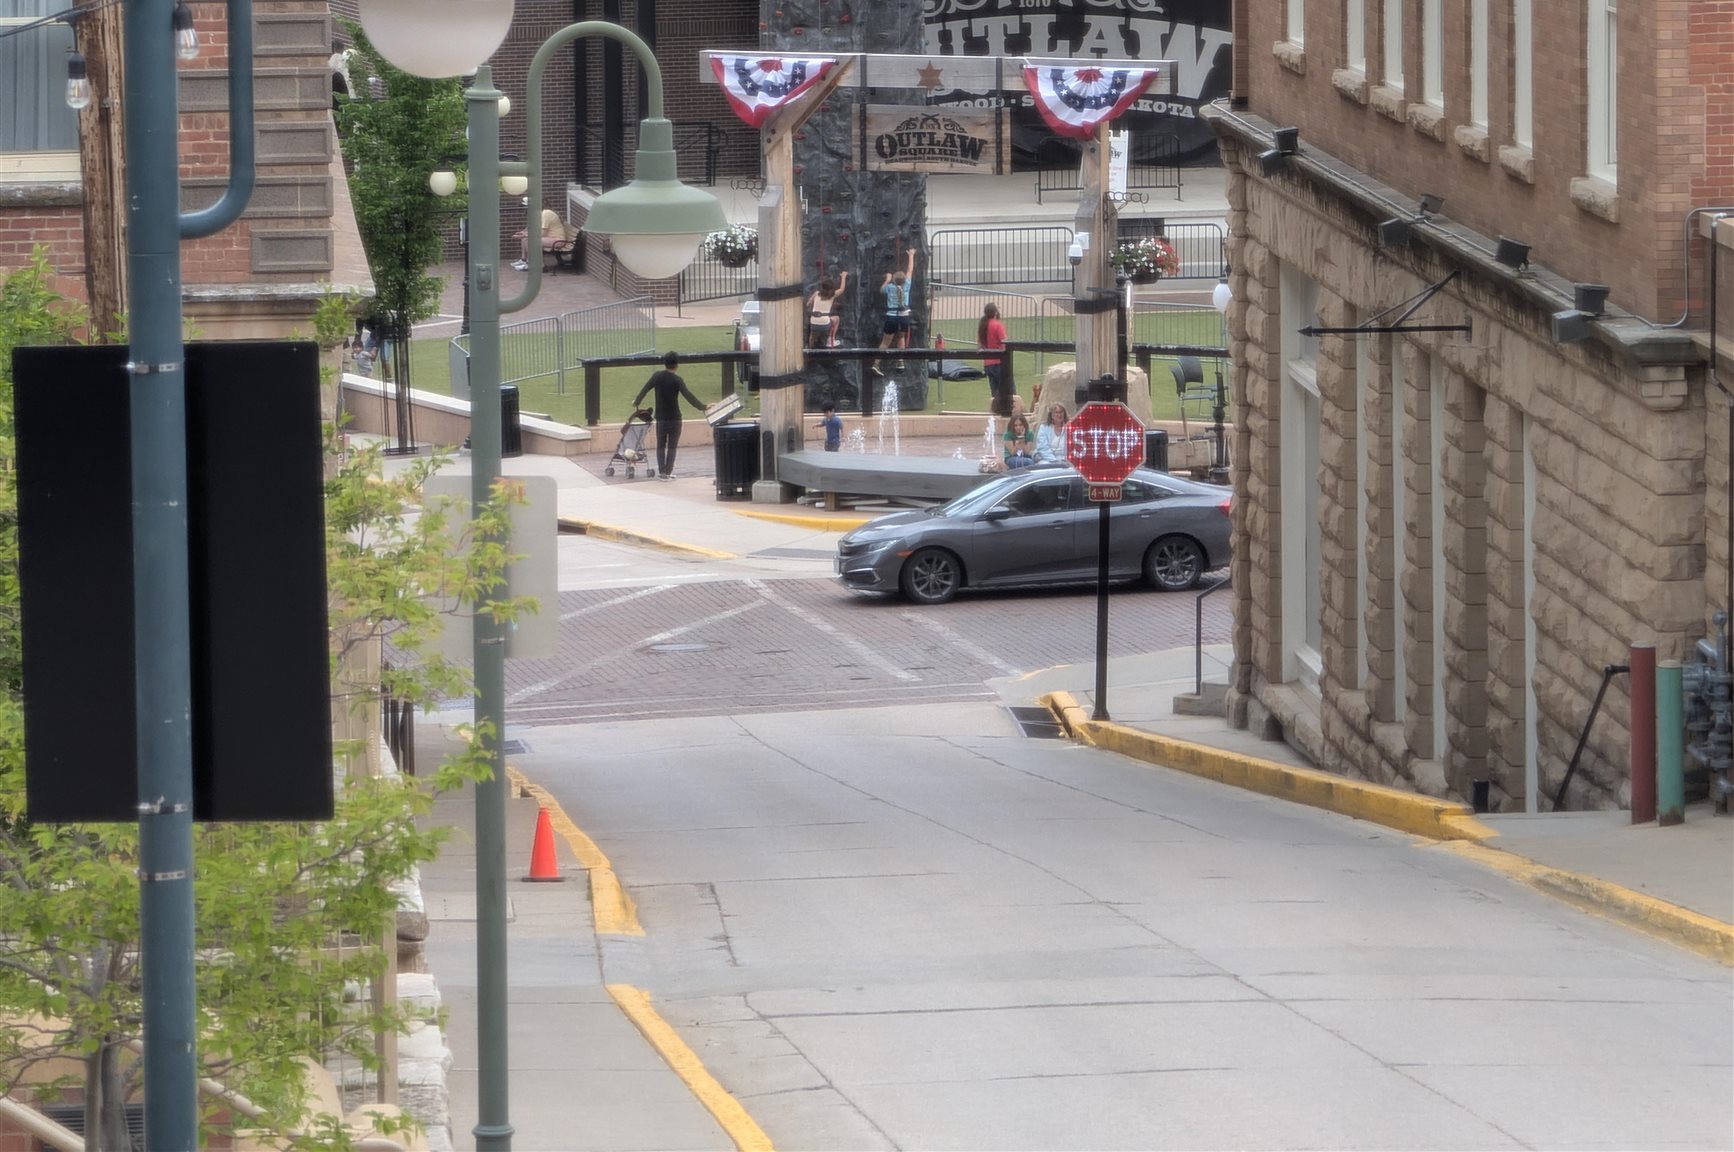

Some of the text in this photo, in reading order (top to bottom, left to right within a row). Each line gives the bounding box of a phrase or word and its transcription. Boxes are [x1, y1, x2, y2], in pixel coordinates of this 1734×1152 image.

[924, 13, 1232, 99] UTLAW
[1128, 98, 1196, 119] KOTA
[875, 131, 988, 161] OUTLAW
[899, 147, 958, 157] SQUARE
[1073, 428, 1138, 459] STOP
[1091, 488, 1120, 498] 4-WAY
